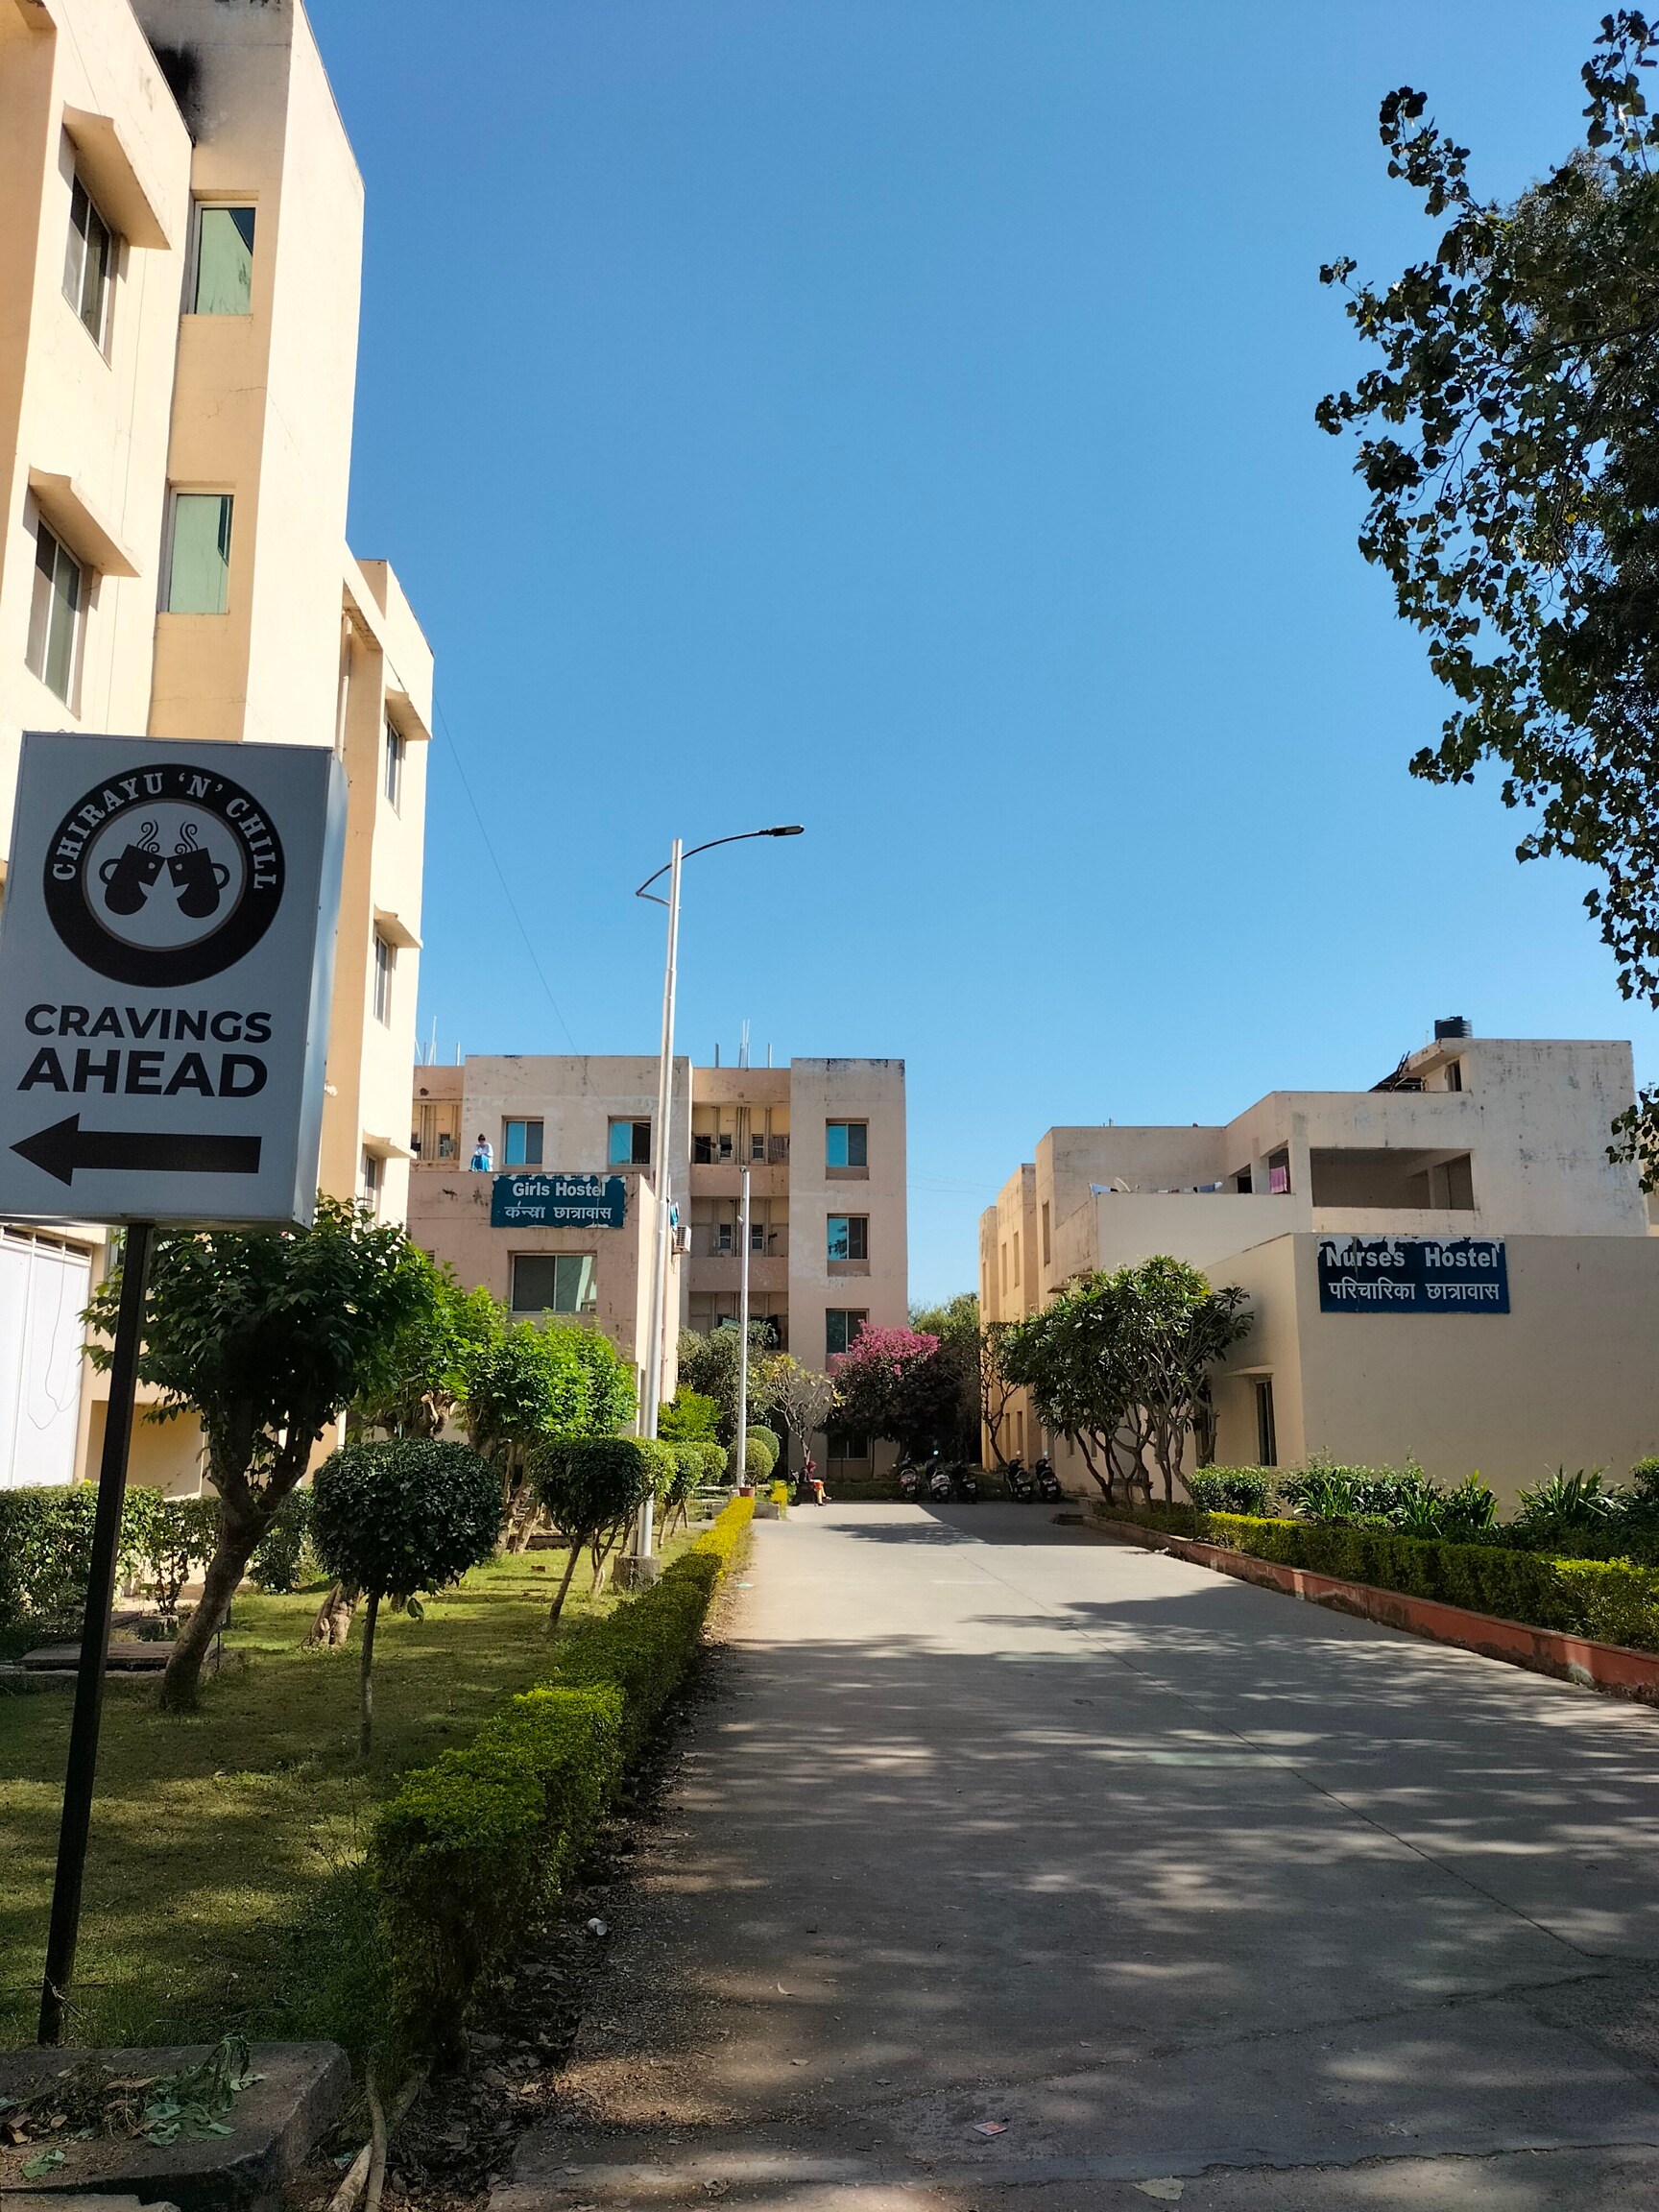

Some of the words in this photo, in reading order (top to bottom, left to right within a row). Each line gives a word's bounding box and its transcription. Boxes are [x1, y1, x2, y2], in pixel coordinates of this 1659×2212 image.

[52, 772, 163, 881] CHIRAYU
[226, 797, 276, 890] CHILL
[24, 1003, 273, 1045] CRAVINGS
[16, 1046, 268, 1098] AHEAD
[512, 1181, 550, 1197] Girls
[555, 1181, 606, 1197] Hostel
[553, 1206, 613, 1219] छात्रावास
[1326, 1246, 1406, 1267] Nurses
[1425, 1246, 1499, 1267] Hostel
[1328, 1276, 1416, 1300] परिचारिका
[1425, 1283, 1500, 1300] छात्रावास
